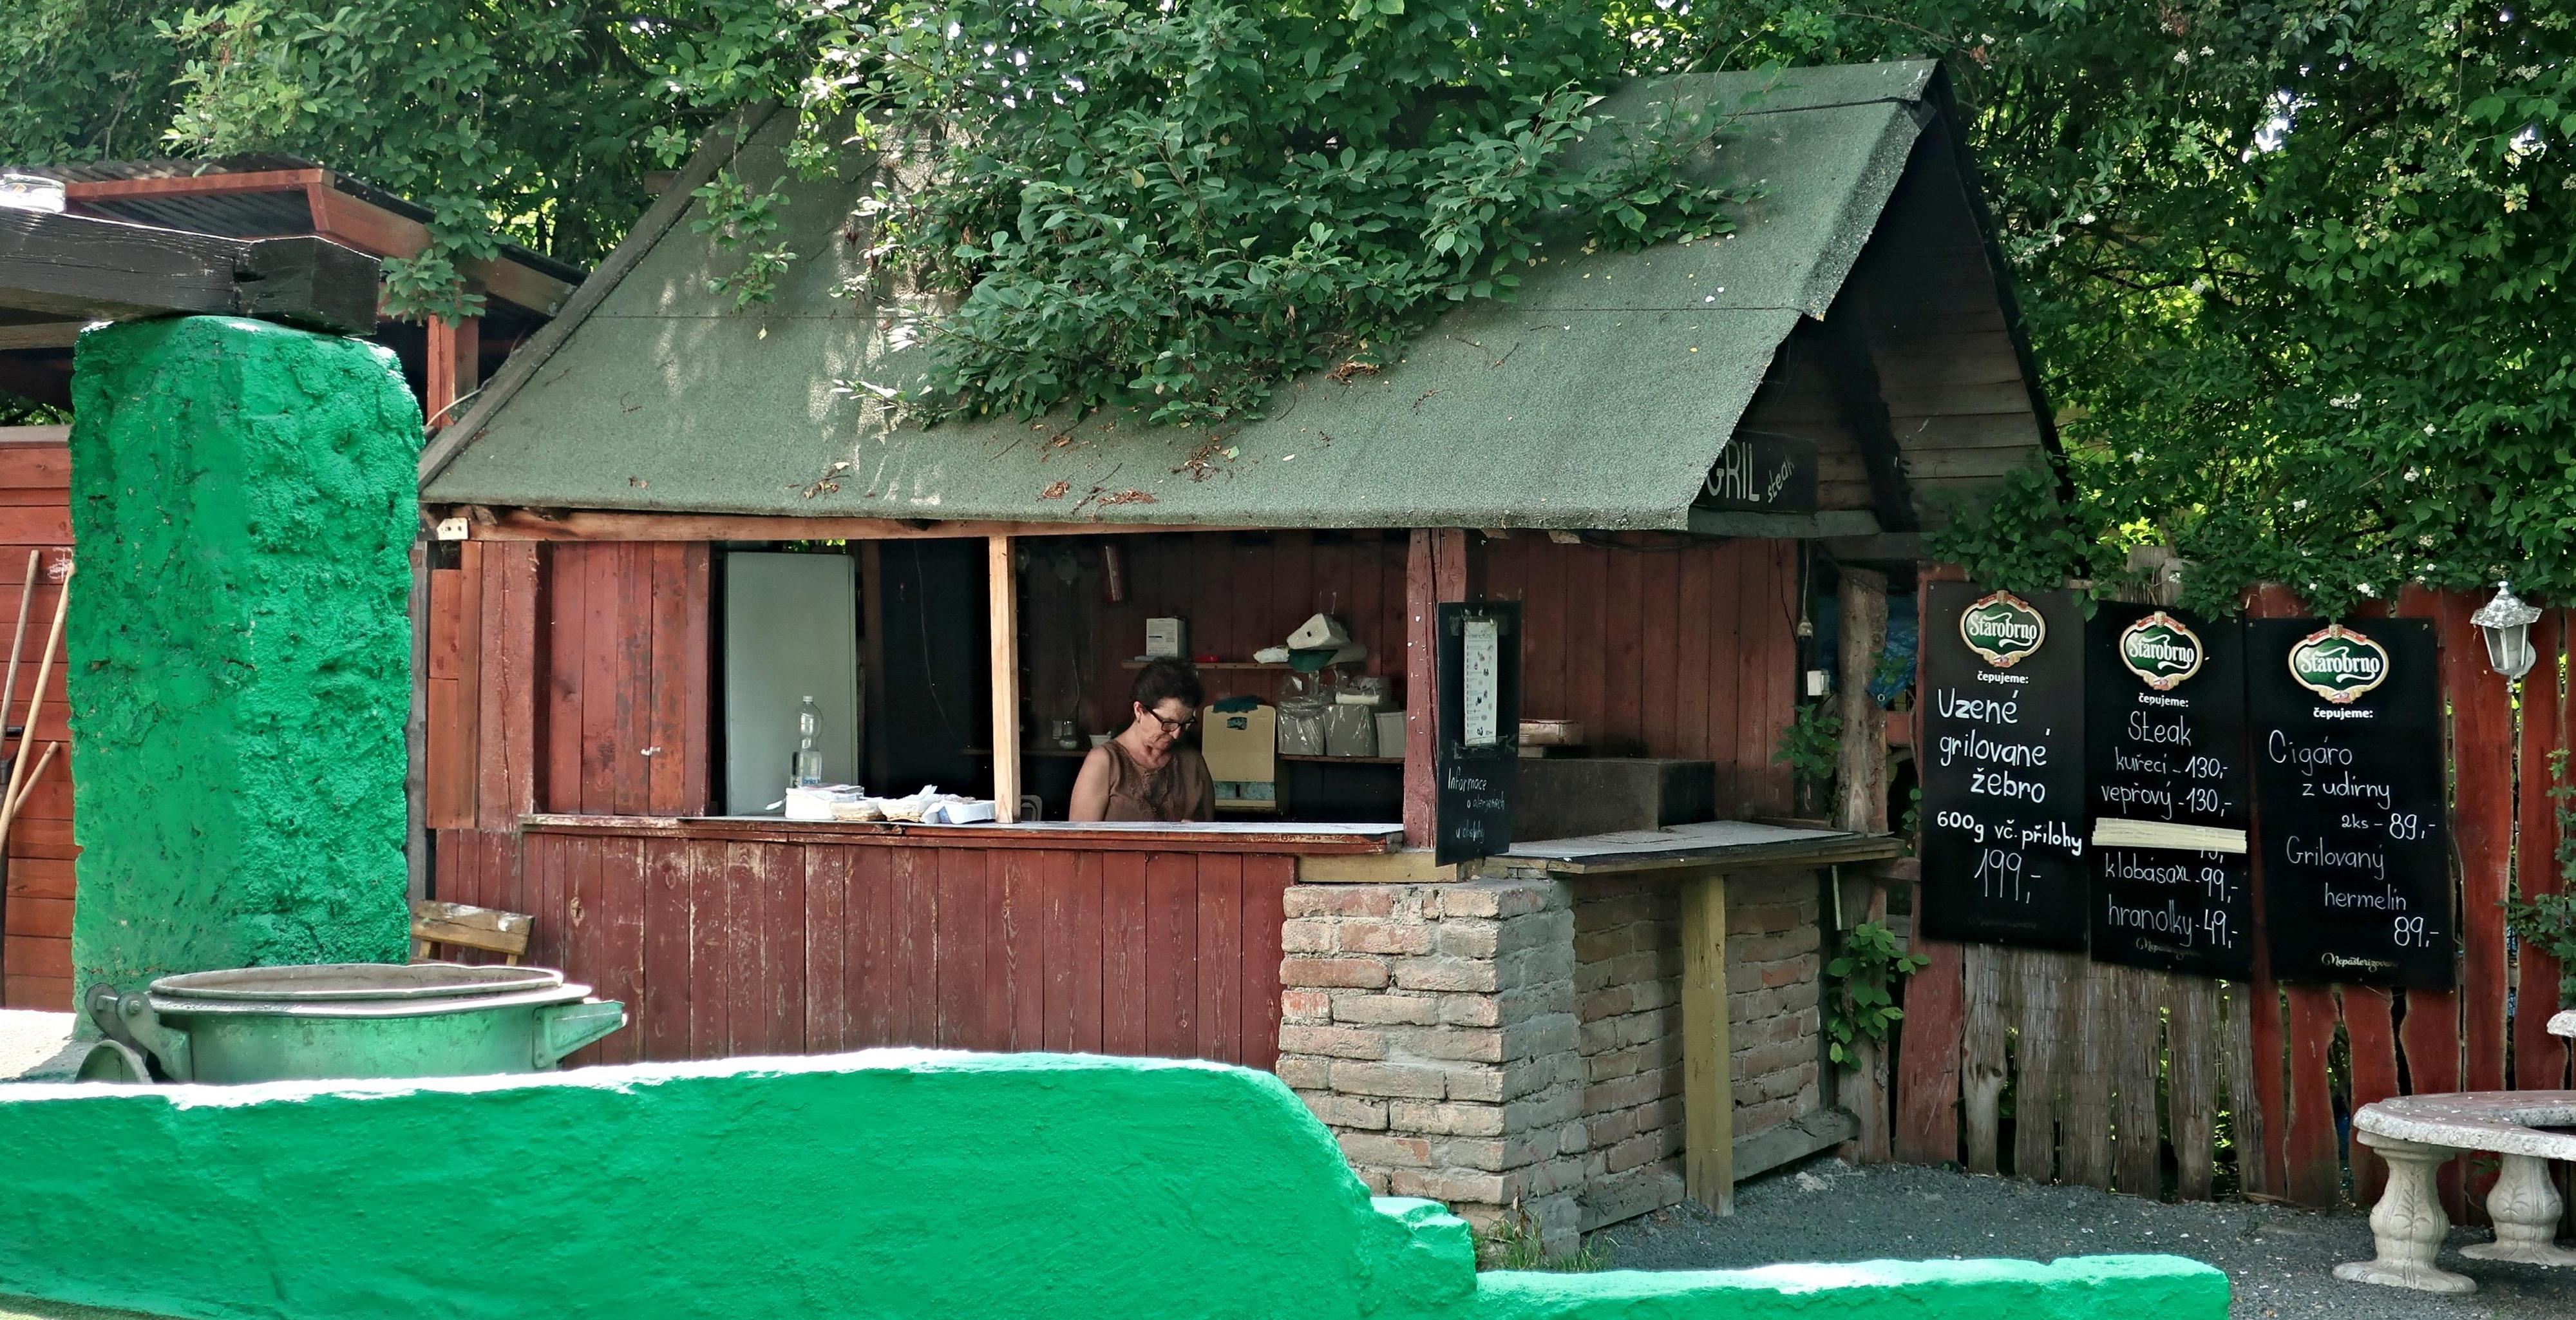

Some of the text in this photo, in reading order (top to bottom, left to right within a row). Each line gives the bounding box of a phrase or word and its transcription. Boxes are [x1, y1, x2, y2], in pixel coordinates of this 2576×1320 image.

[1969, 613, 2038, 647] Starobrno
[2129, 634, 2195, 670] Starobrno
[2300, 646, 2380, 683] Starobrno
[1977, 671, 2029, 684] čepujeme:
[1938, 688, 2018, 724] Uzené
[2138, 693, 2189, 707] čepujeme:
[2313, 707, 2373, 720] čepujeme:
[2128, 711, 2192, 746] Steak
[1940, 728, 2050, 767] grilované
[2269, 729, 2353, 776] Cigáro
[1448, 765, 1487, 792] Informace
[1970, 767, 2046, 803] žebro
[2302, 770, 2391, 810] z udírny
[1466, 799, 1472, 809] o
[2101, 781, 2172, 820] vepřový
[1455, 827, 1461, 839] u
[1937, 810, 1984, 843] 600g
[2341, 813, 2369, 829] 2ks
[2286, 836, 2384, 881] Grilovaný
[2108, 894, 2192, 947] hranolky
